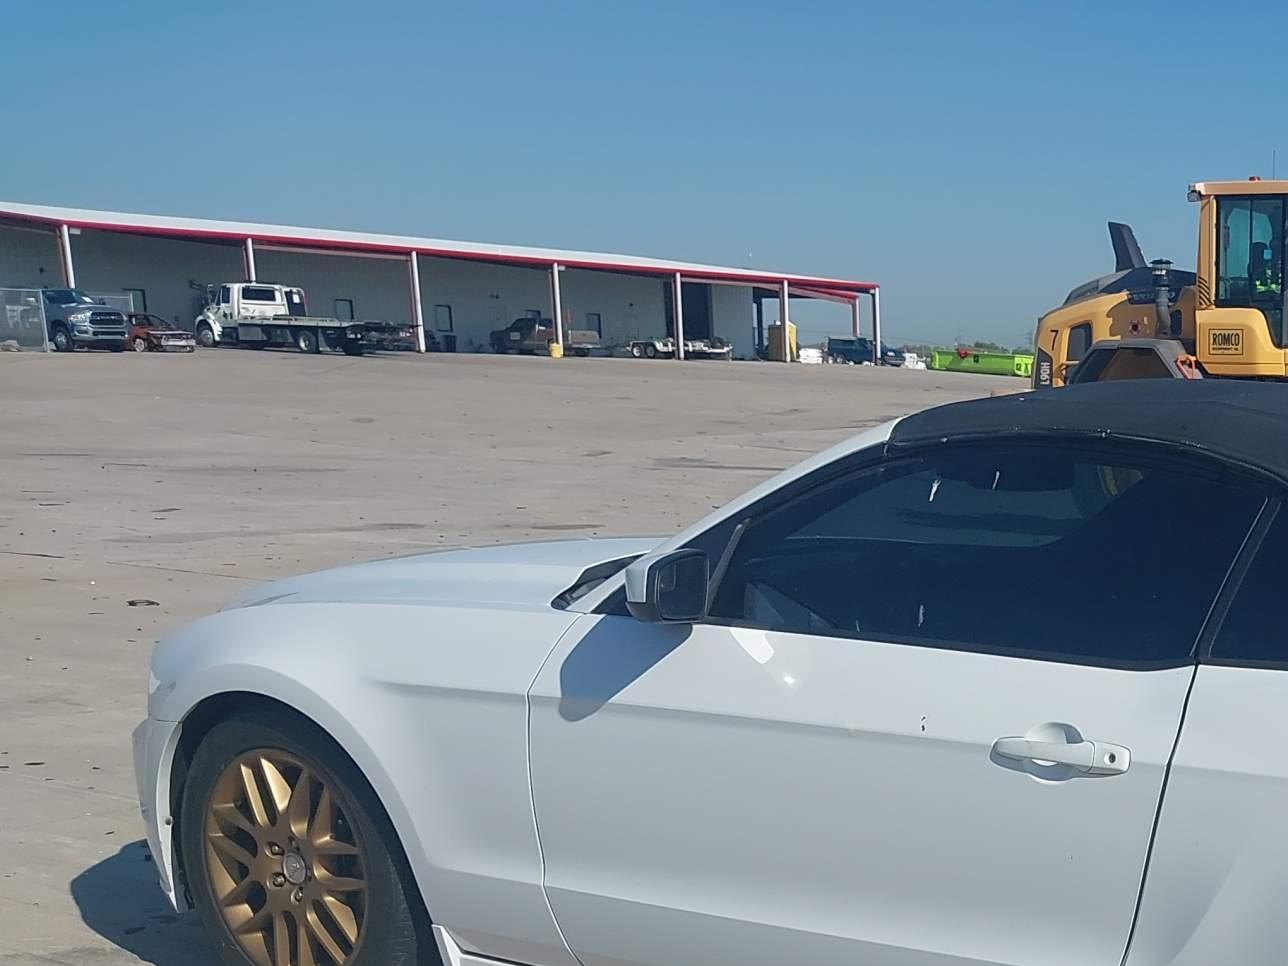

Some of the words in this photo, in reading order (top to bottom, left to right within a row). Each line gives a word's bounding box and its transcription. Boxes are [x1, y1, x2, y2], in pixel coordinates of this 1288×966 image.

[1049, 329, 1060, 351] 7
[1212, 332, 1241, 347] ROMCO
[1039, 362, 1051, 385] L90H
